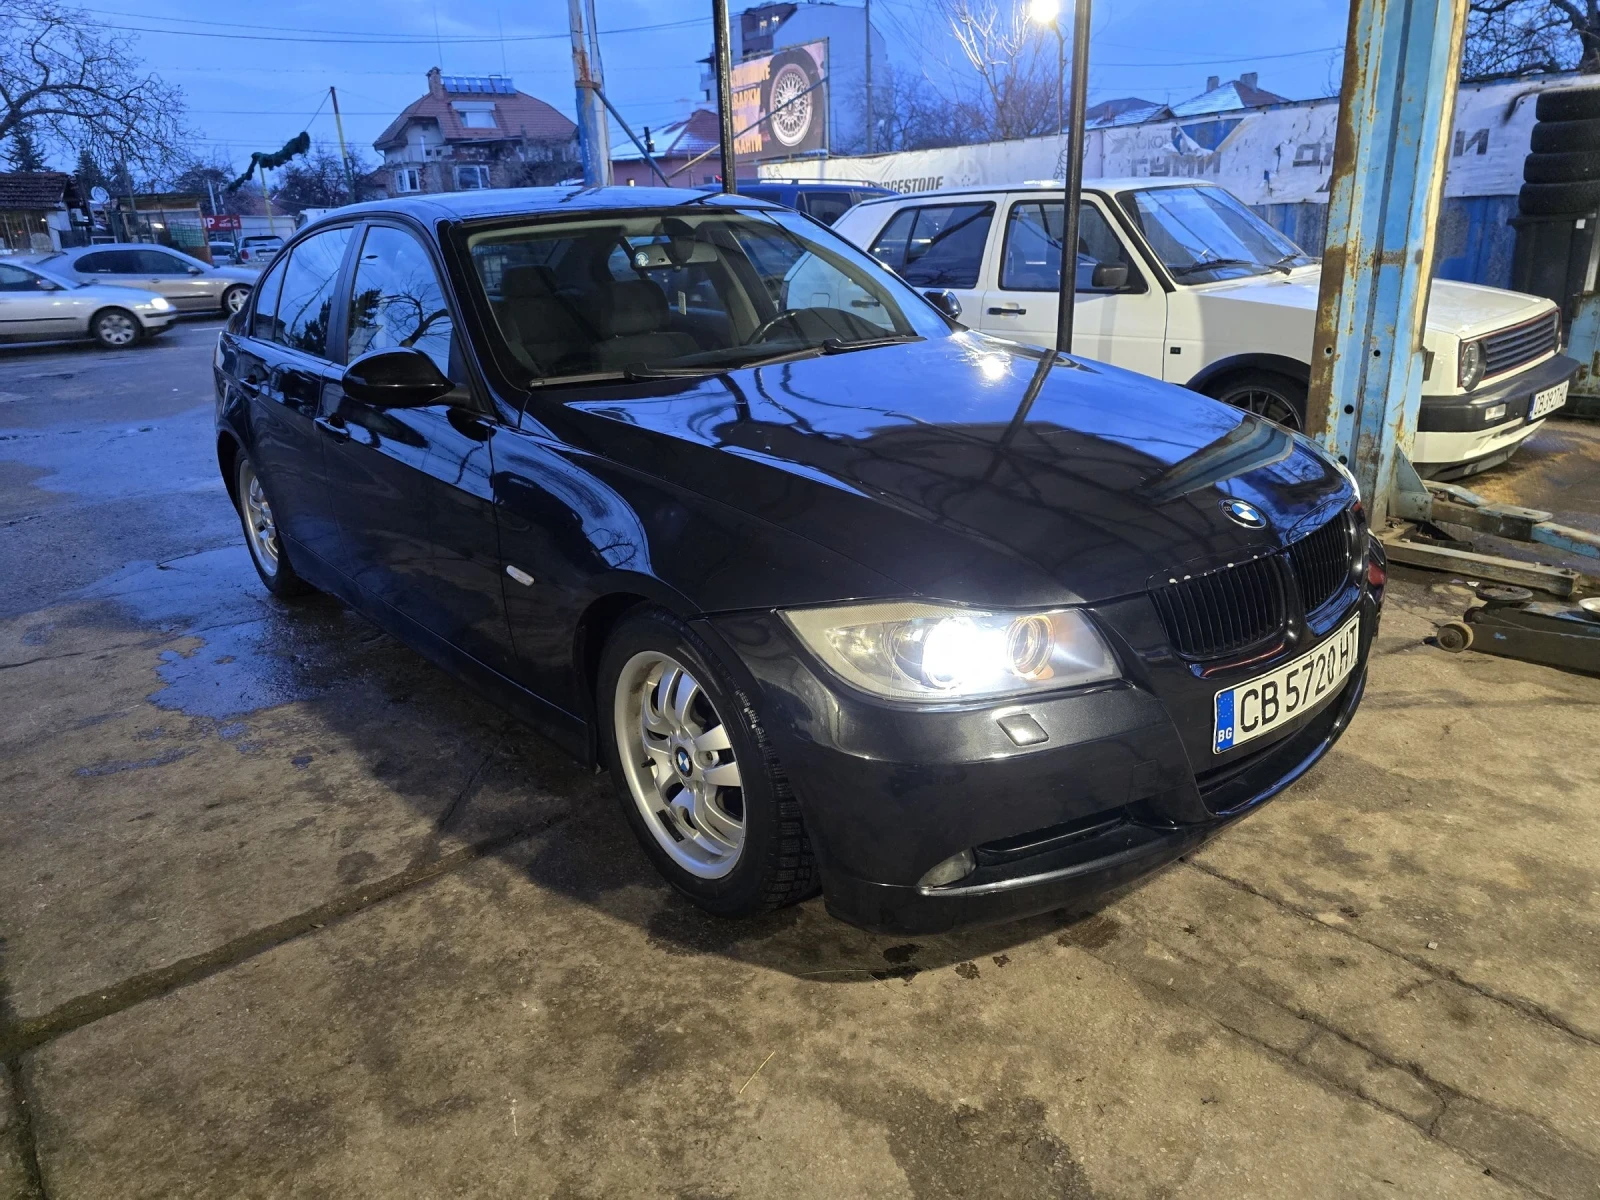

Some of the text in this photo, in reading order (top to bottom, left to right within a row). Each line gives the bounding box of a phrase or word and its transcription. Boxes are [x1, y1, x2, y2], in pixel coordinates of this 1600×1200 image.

[1240, 623, 1357, 732] CB 5720 HT
[1217, 727, 1233, 743] BG
